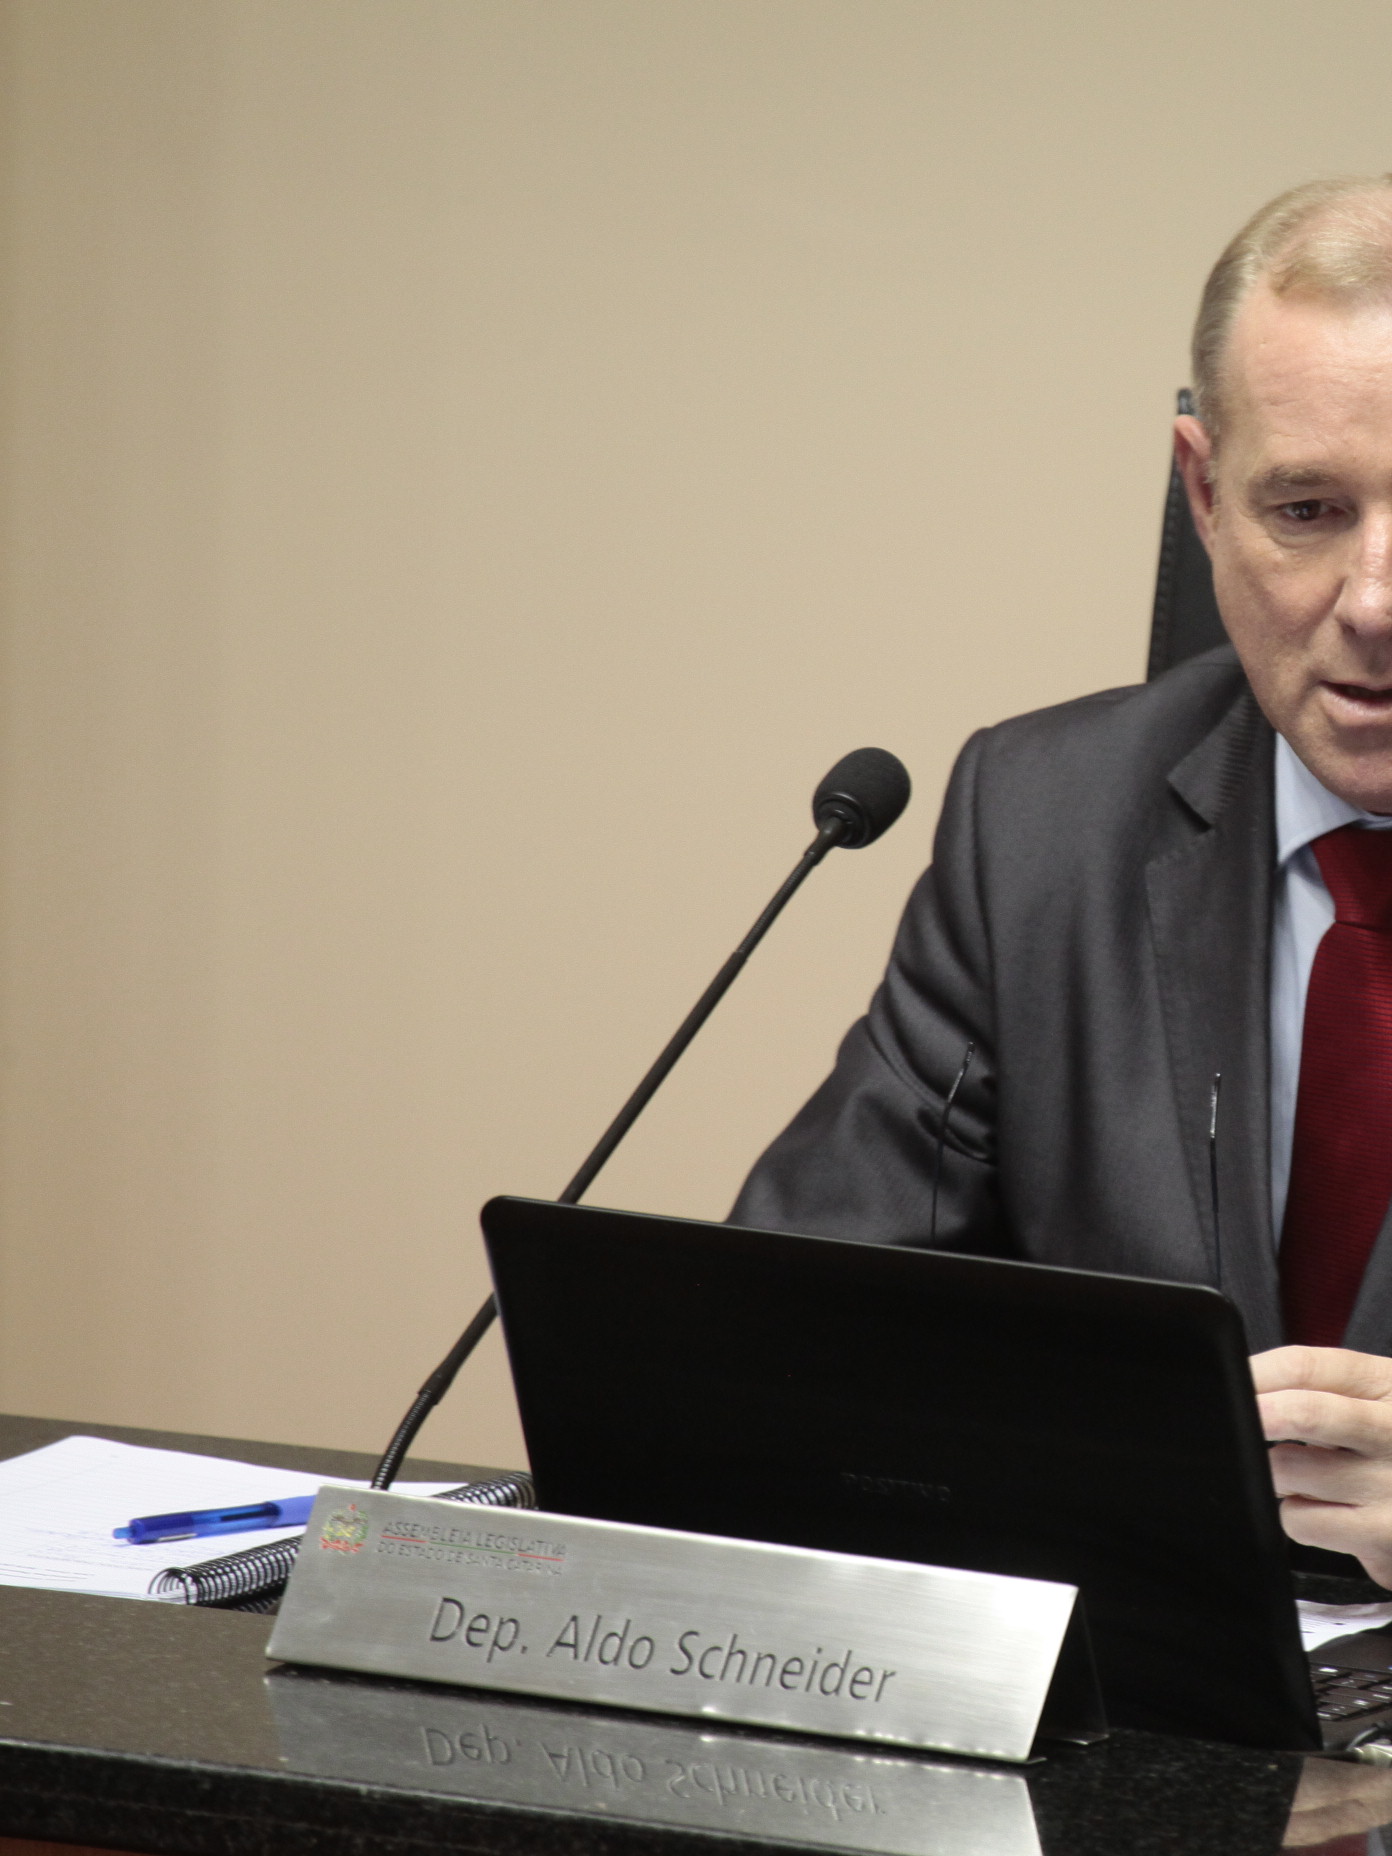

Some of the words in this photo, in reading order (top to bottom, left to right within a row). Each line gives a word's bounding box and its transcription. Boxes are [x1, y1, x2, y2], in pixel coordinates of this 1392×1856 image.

[381, 1521, 471, 1544] ASSEMBLEIA
[475, 1530, 566, 1557] LEGISLATIVA
[428, 1596, 528, 1664] Dep.
[547, 1613, 656, 1671] Aldo
[669, 1630, 897, 1703] Schneider
